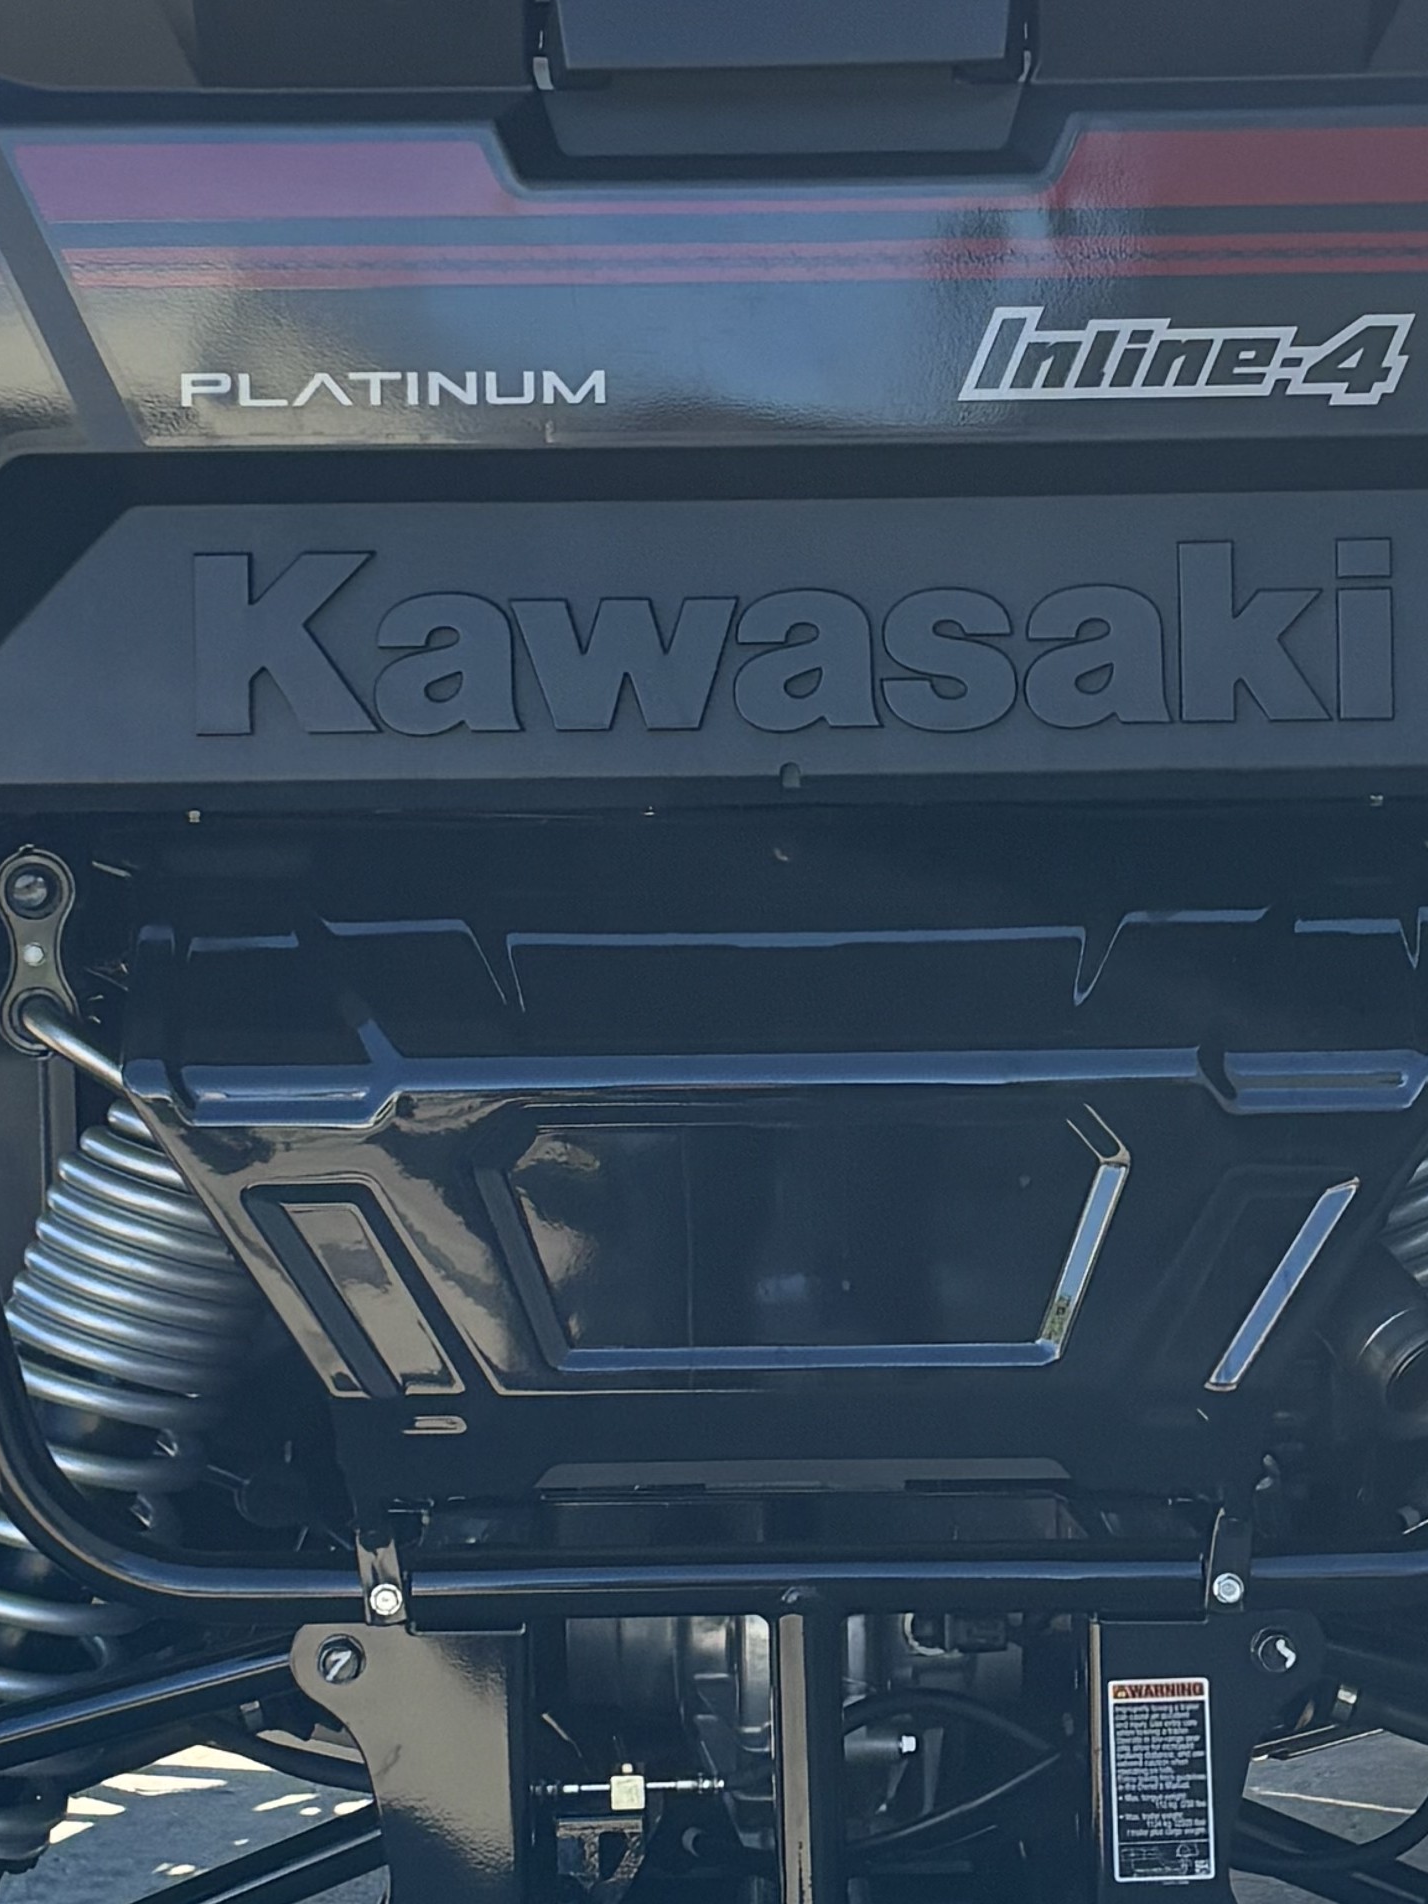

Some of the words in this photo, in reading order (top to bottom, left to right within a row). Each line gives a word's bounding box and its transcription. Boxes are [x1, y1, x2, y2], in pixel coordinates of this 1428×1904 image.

[180, 367, 607, 409] PLATINUM
[192, 537, 1396, 738] Kawasaki
[1128, 1683, 1204, 1698] WARNING
